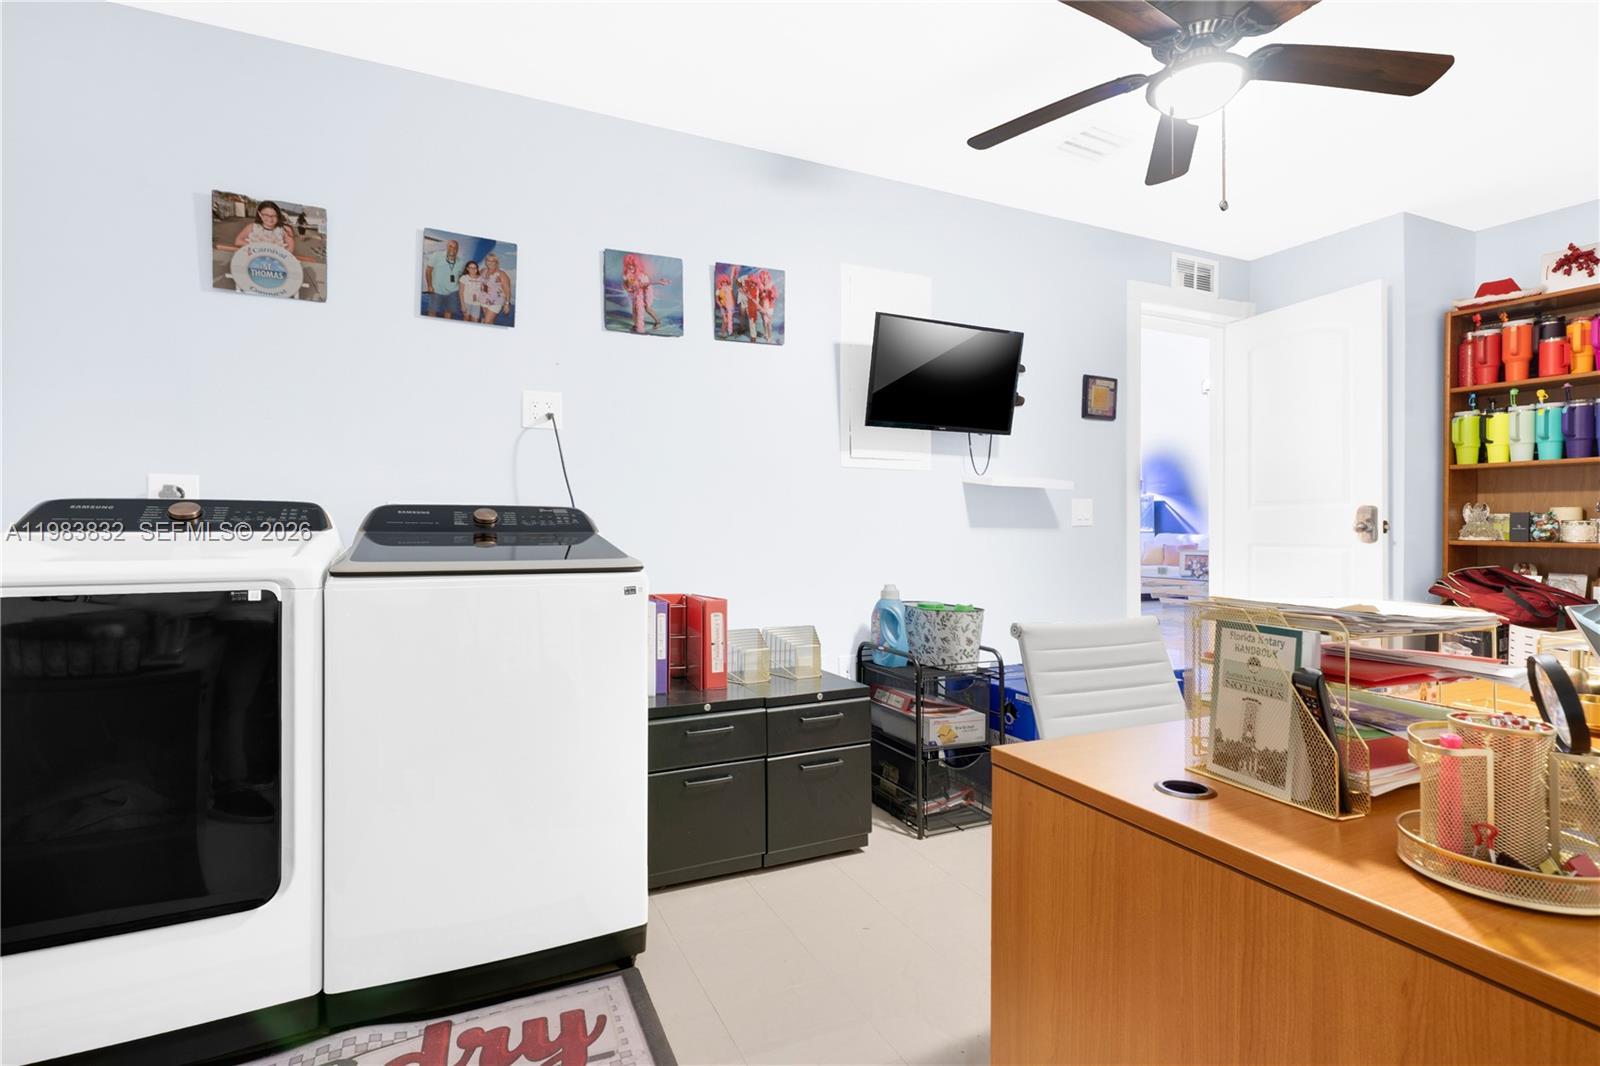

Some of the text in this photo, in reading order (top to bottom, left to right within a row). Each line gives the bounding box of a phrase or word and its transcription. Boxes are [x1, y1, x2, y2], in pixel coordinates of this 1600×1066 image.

[250, 270, 284, 280] THOMAS
[1230, 631, 1285, 650] Florida Notary
